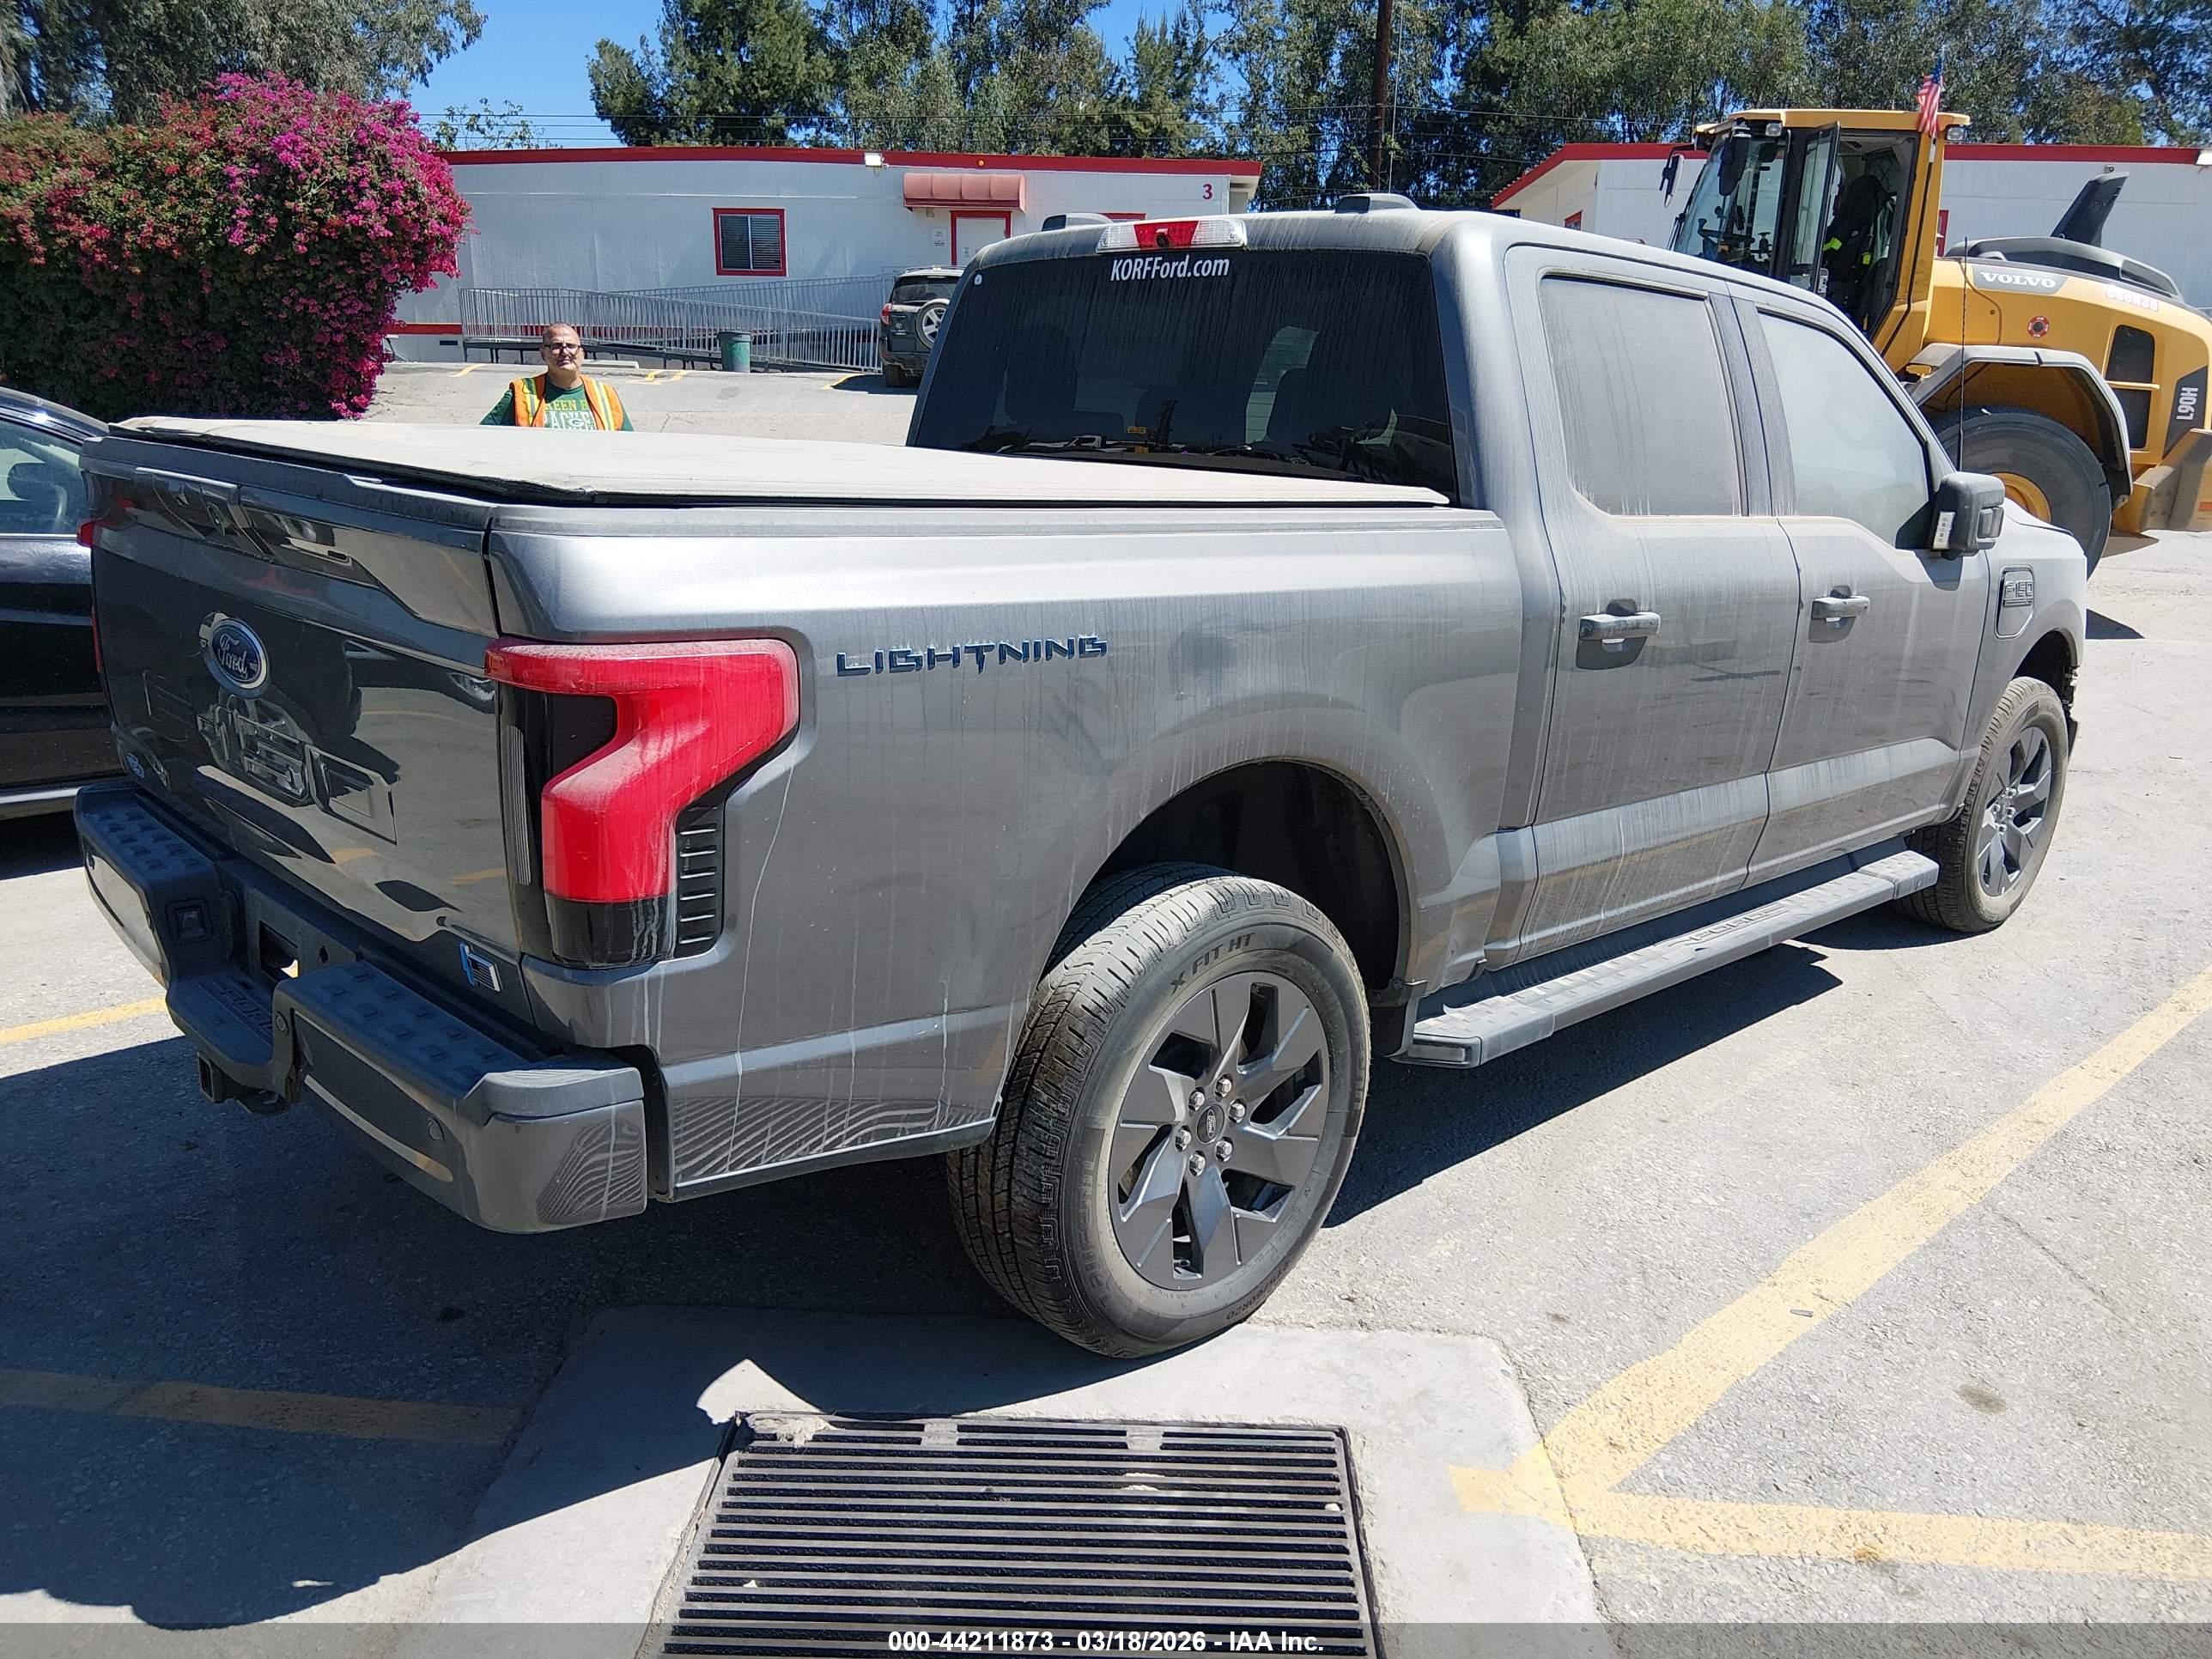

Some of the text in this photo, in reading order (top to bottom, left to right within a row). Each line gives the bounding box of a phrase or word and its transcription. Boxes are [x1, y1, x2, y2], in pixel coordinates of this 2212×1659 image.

[1202, 183, 1212, 200] 3
[1109, 254, 1231, 282] KORFFord.com
[1979, 271, 2057, 289] VOLVO
[2176, 386, 2199, 421] L90H
[217, 633, 249, 679] Ford
[836, 635, 1108, 678] LIGHTNING
[1192, 944, 1223, 975] FIT
[1228, 933, 1255, 953] HT
